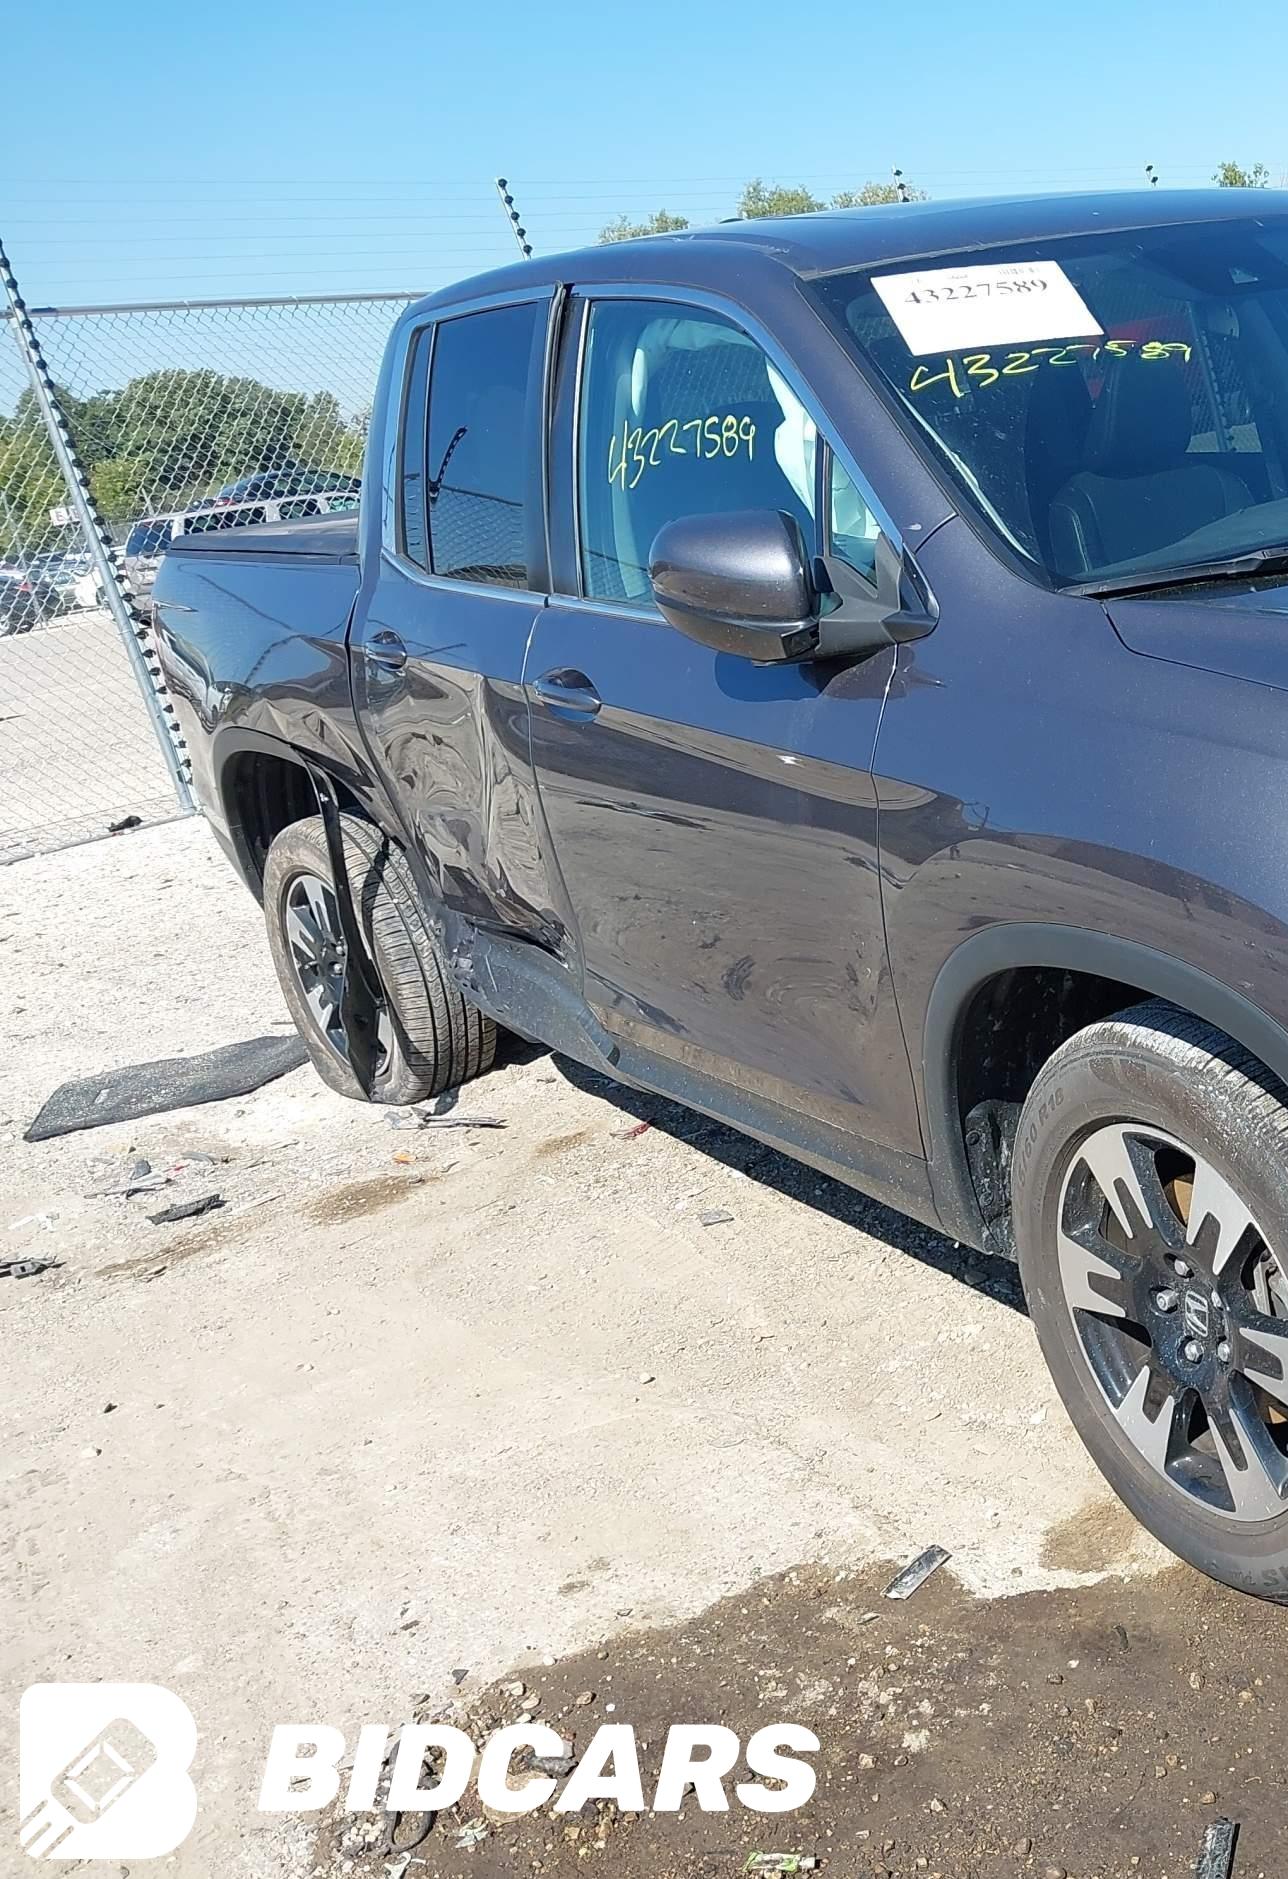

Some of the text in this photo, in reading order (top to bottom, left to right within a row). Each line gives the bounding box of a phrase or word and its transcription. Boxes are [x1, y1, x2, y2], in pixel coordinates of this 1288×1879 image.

[904, 278, 1048, 305] 43227589
[910, 340, 1191, 398] 43227589
[607, 415, 756, 491] 43227589
